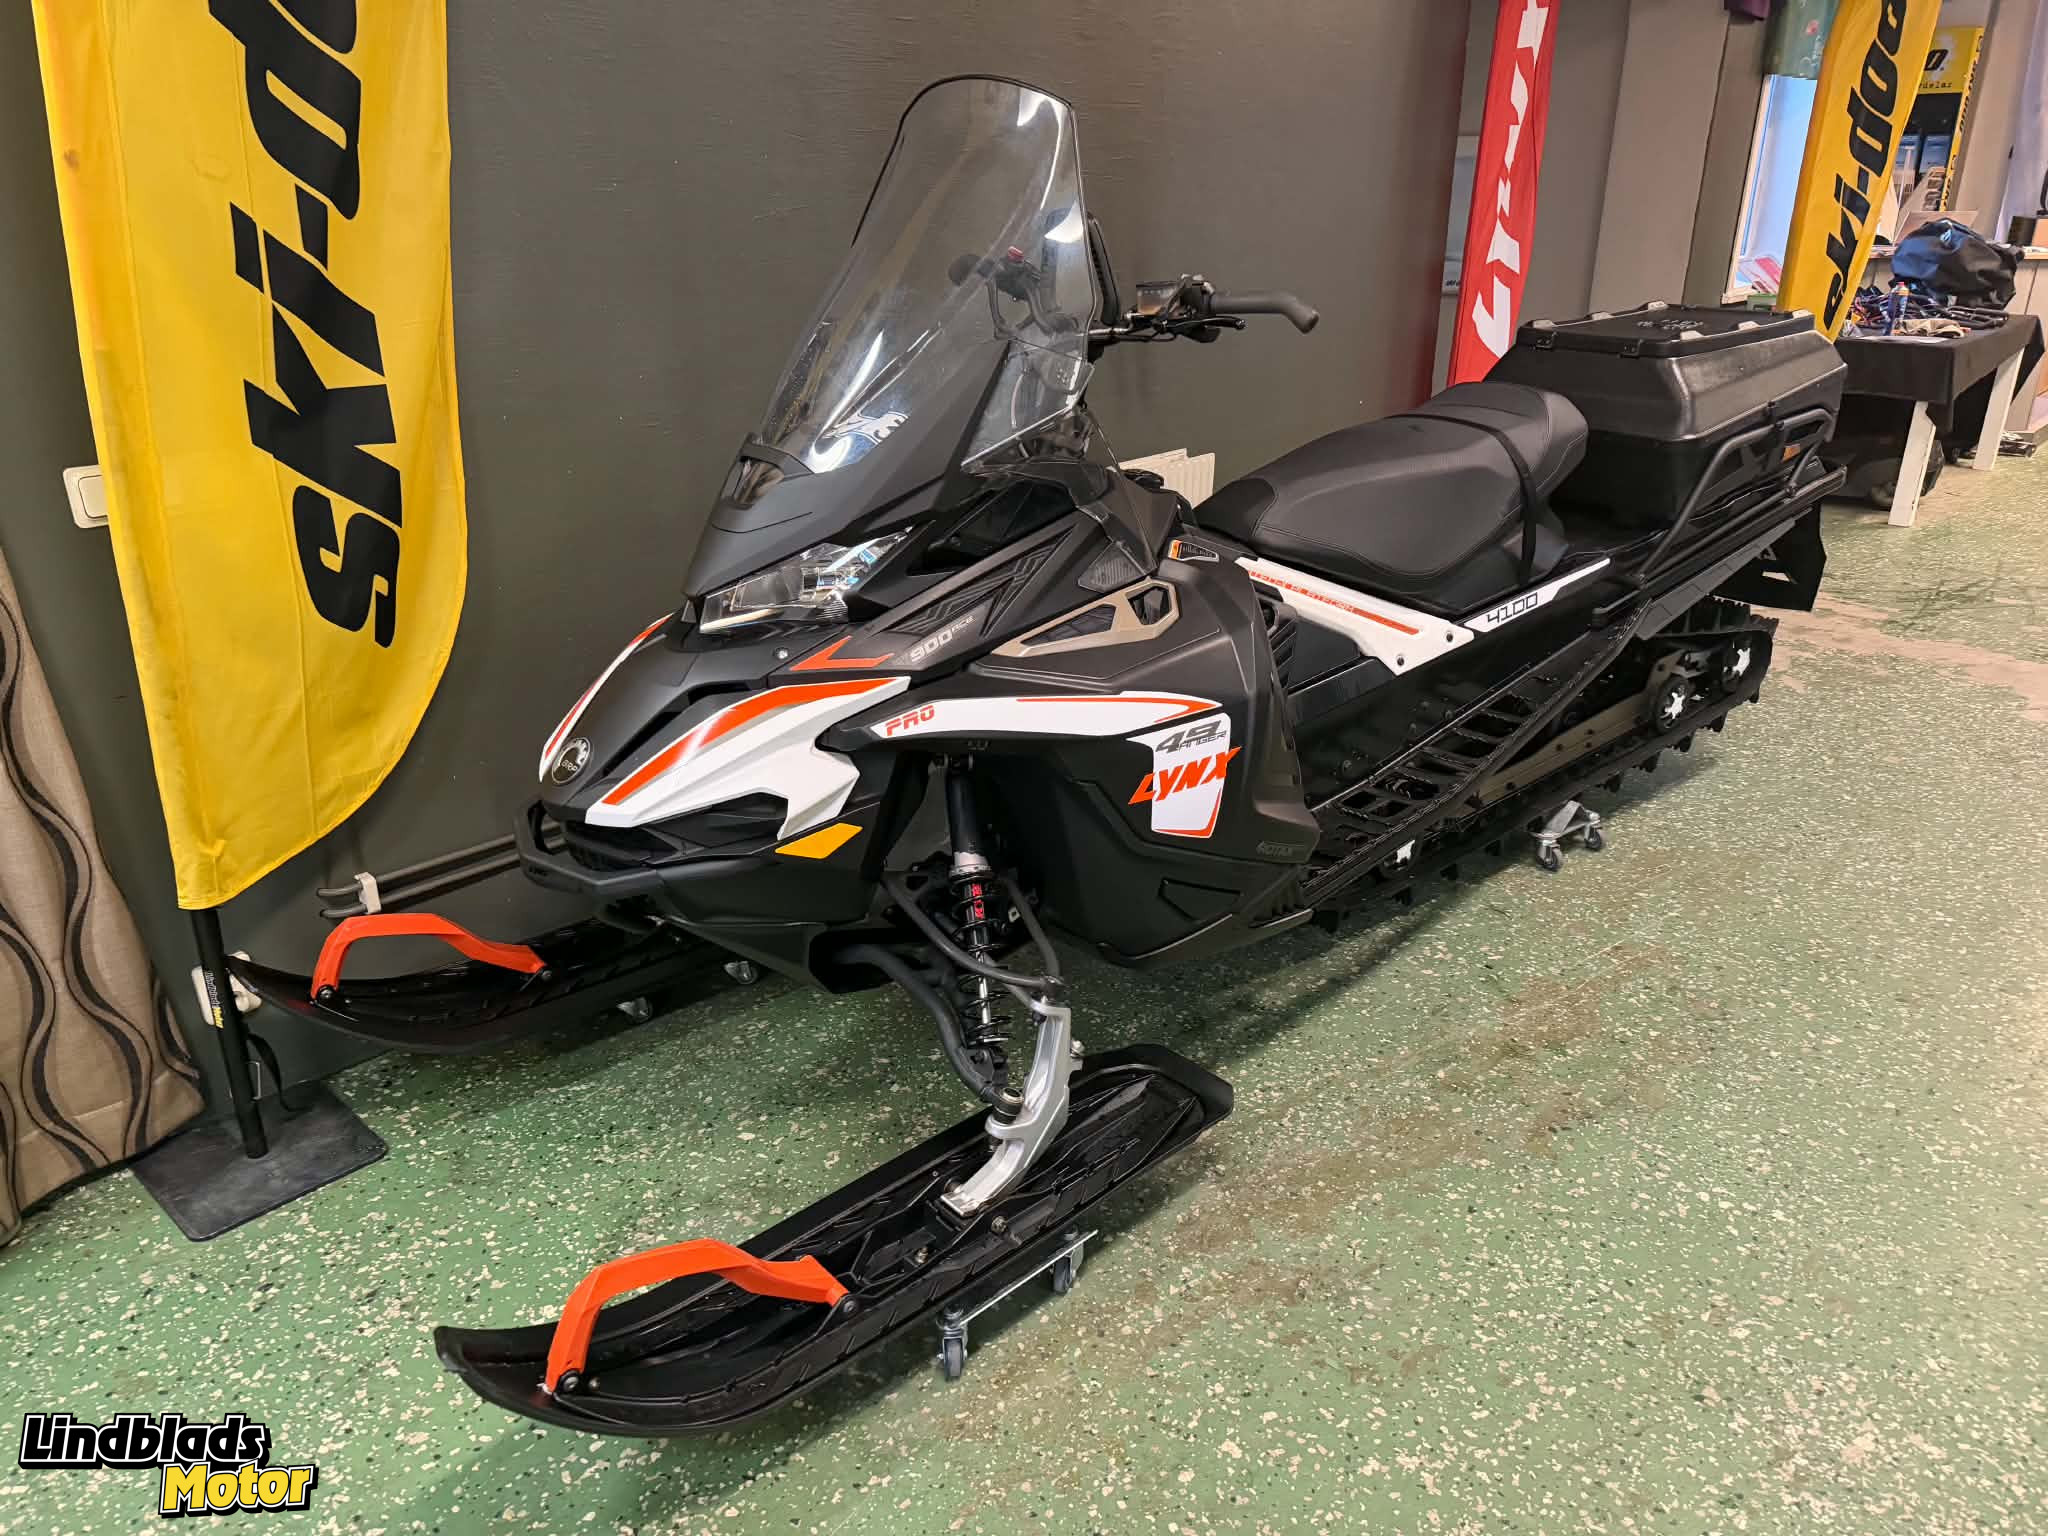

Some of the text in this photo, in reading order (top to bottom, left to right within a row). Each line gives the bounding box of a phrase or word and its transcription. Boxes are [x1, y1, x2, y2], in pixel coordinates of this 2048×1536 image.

[1486, 592, 1538, 623] 4100
[909, 629, 953, 662] 900
[885, 705, 935, 737] PRO
[1155, 720, 1222, 753] 49
[1128, 746, 1242, 805] LYNX
